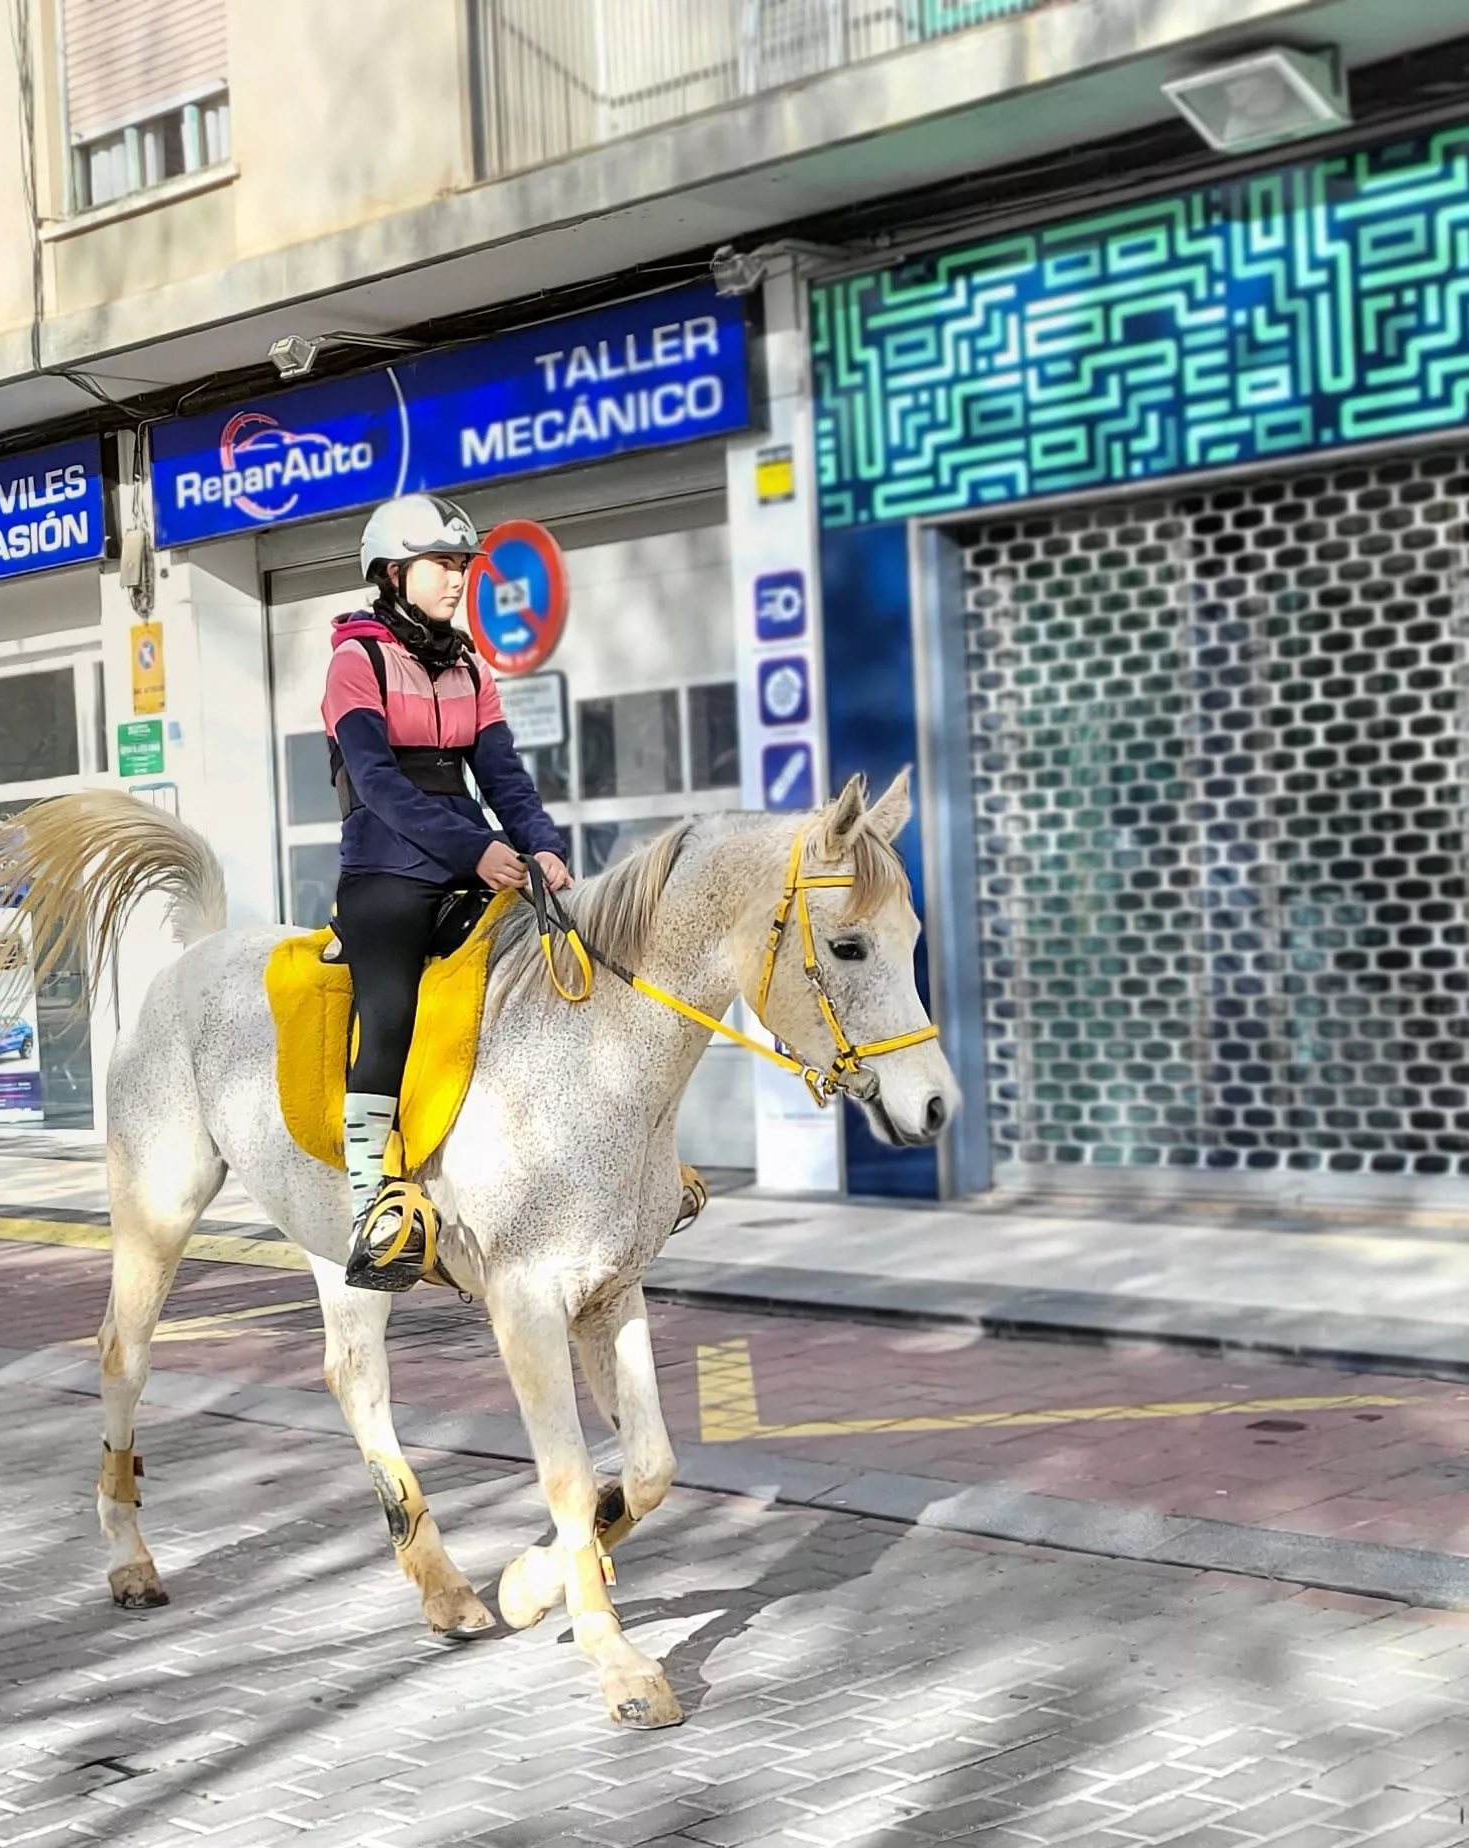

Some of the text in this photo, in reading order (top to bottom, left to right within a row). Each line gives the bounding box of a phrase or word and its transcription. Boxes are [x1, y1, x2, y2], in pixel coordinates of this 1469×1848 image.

[535, 315, 718, 393] TALLER
[460, 376, 722, 468] MECÁNICO
[175, 440, 372, 508] ReparAuto
